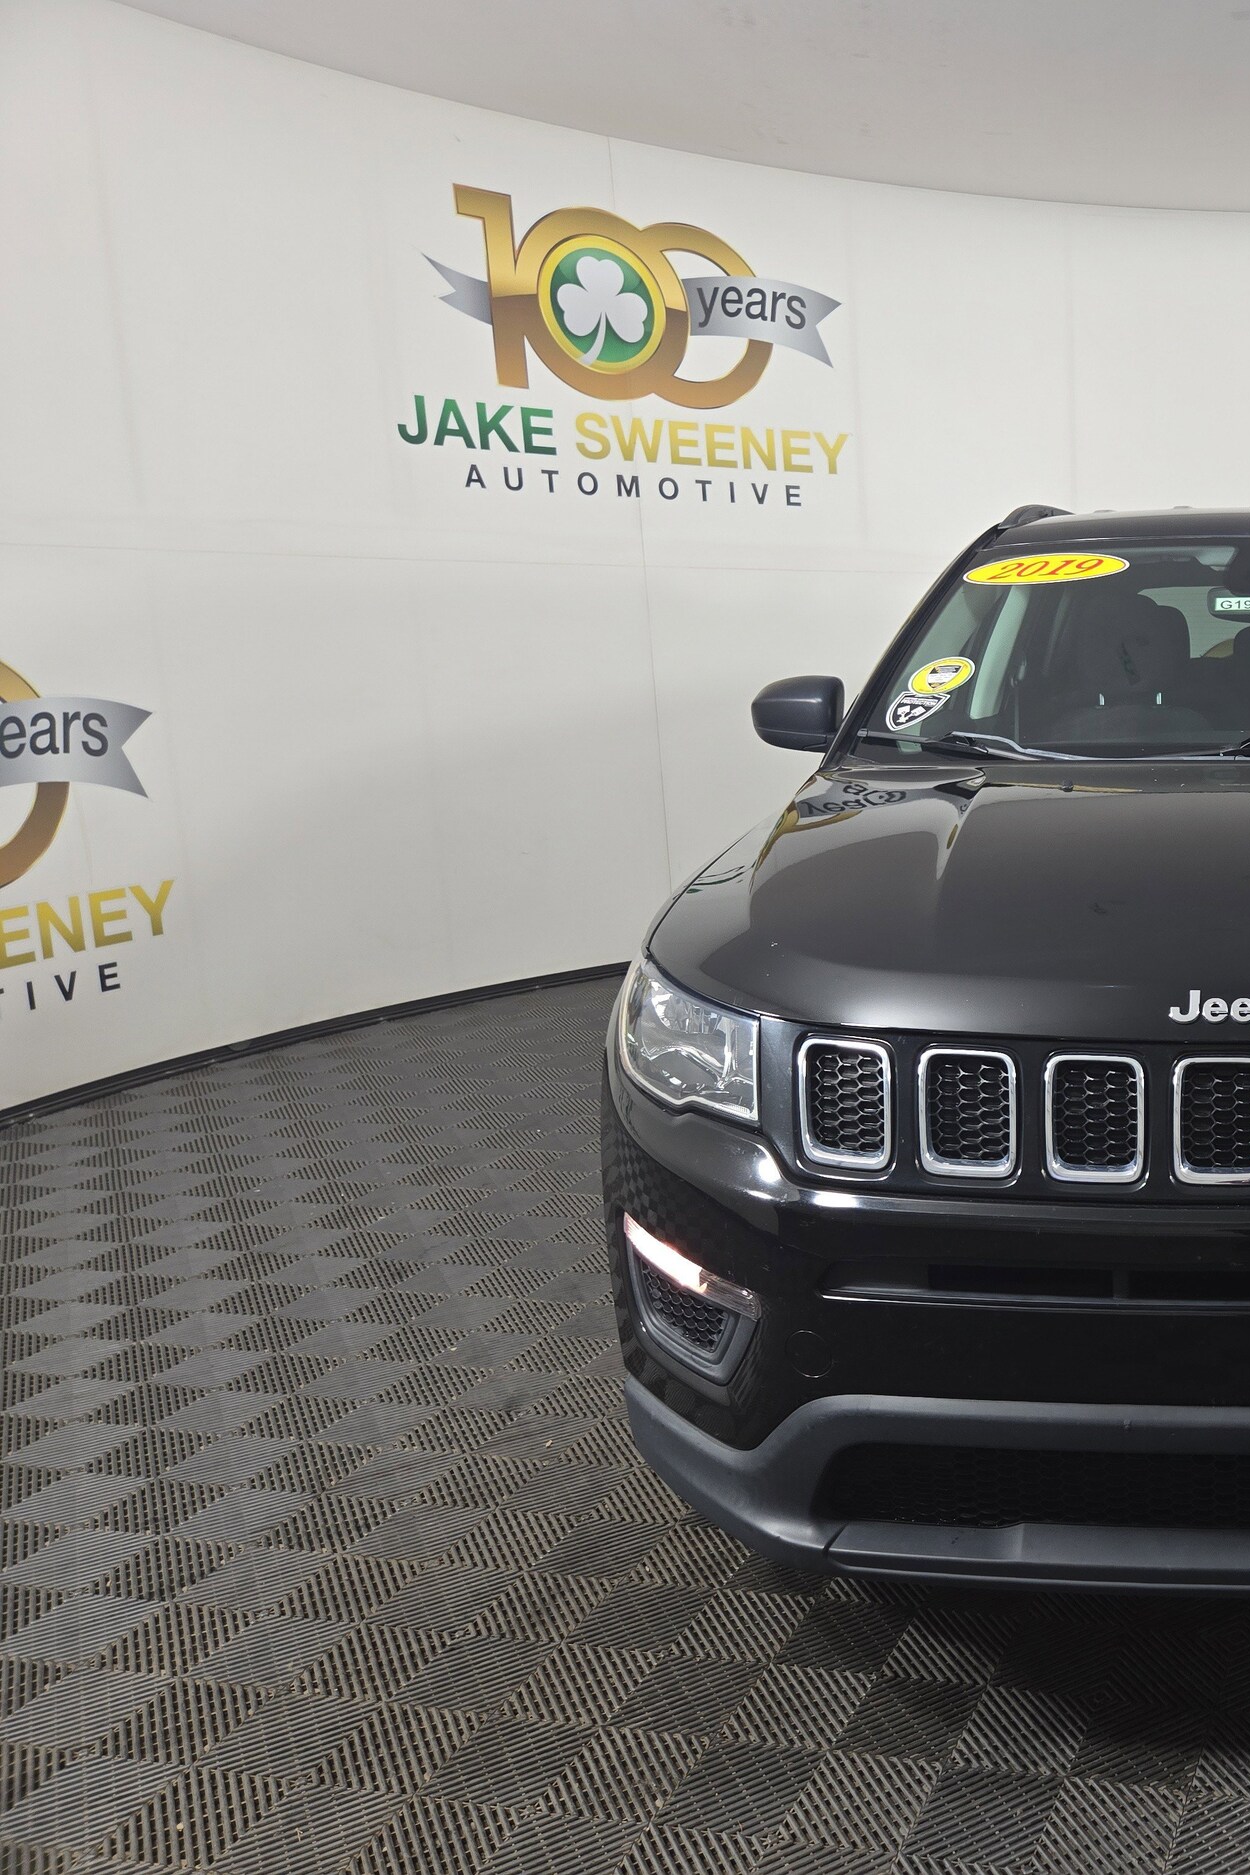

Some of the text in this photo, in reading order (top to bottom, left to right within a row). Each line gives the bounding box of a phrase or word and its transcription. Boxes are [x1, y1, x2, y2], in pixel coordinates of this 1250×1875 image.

[696, 286, 808, 330] years
[397, 394, 849, 475] JAKE SWEENEY
[465, 463, 803, 507] AUTOMOTIVE
[986, 558, 1104, 580] 2019
